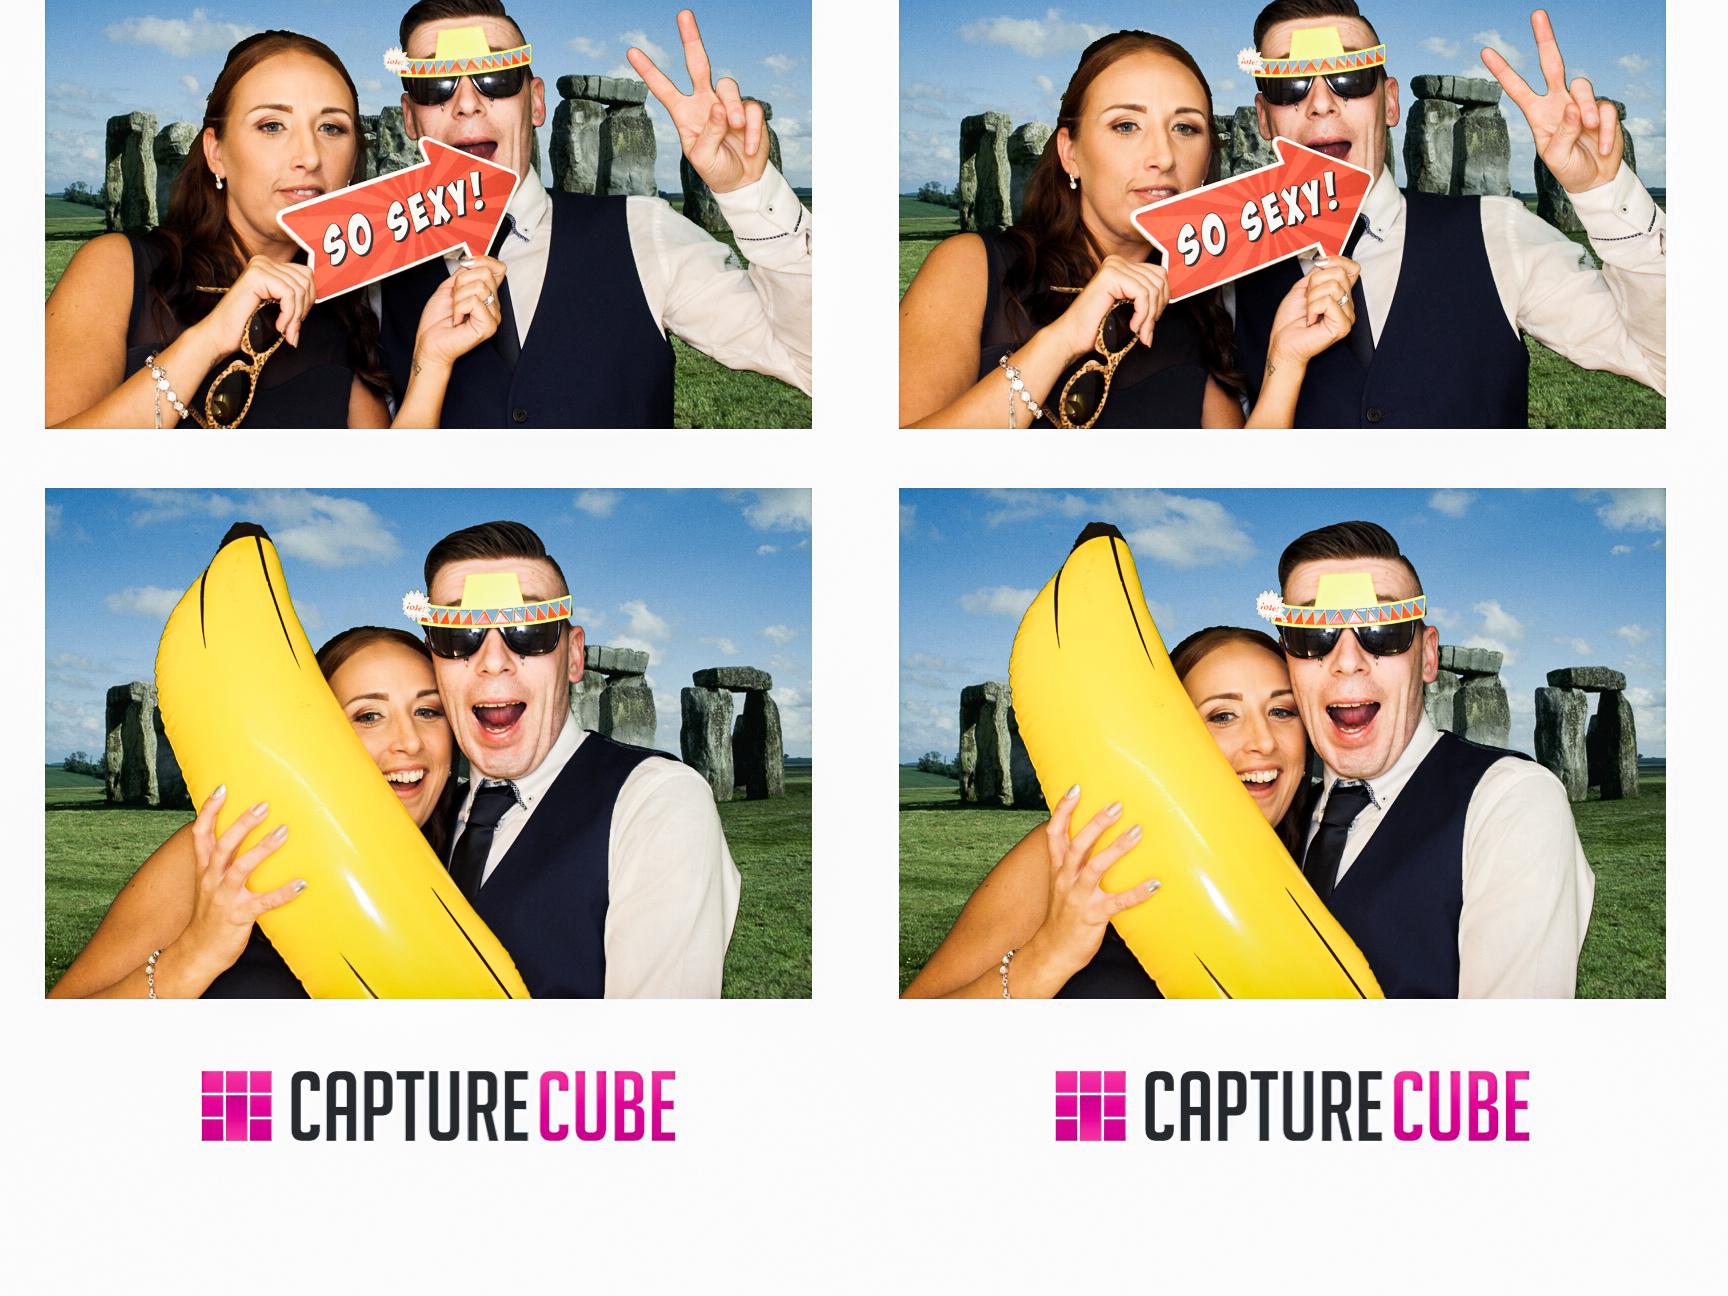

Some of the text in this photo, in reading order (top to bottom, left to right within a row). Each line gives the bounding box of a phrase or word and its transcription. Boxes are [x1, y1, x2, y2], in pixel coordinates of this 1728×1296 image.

[322, 170, 486, 267] SO SEXY!
[1176, 170, 1340, 267] SO SEXY!
